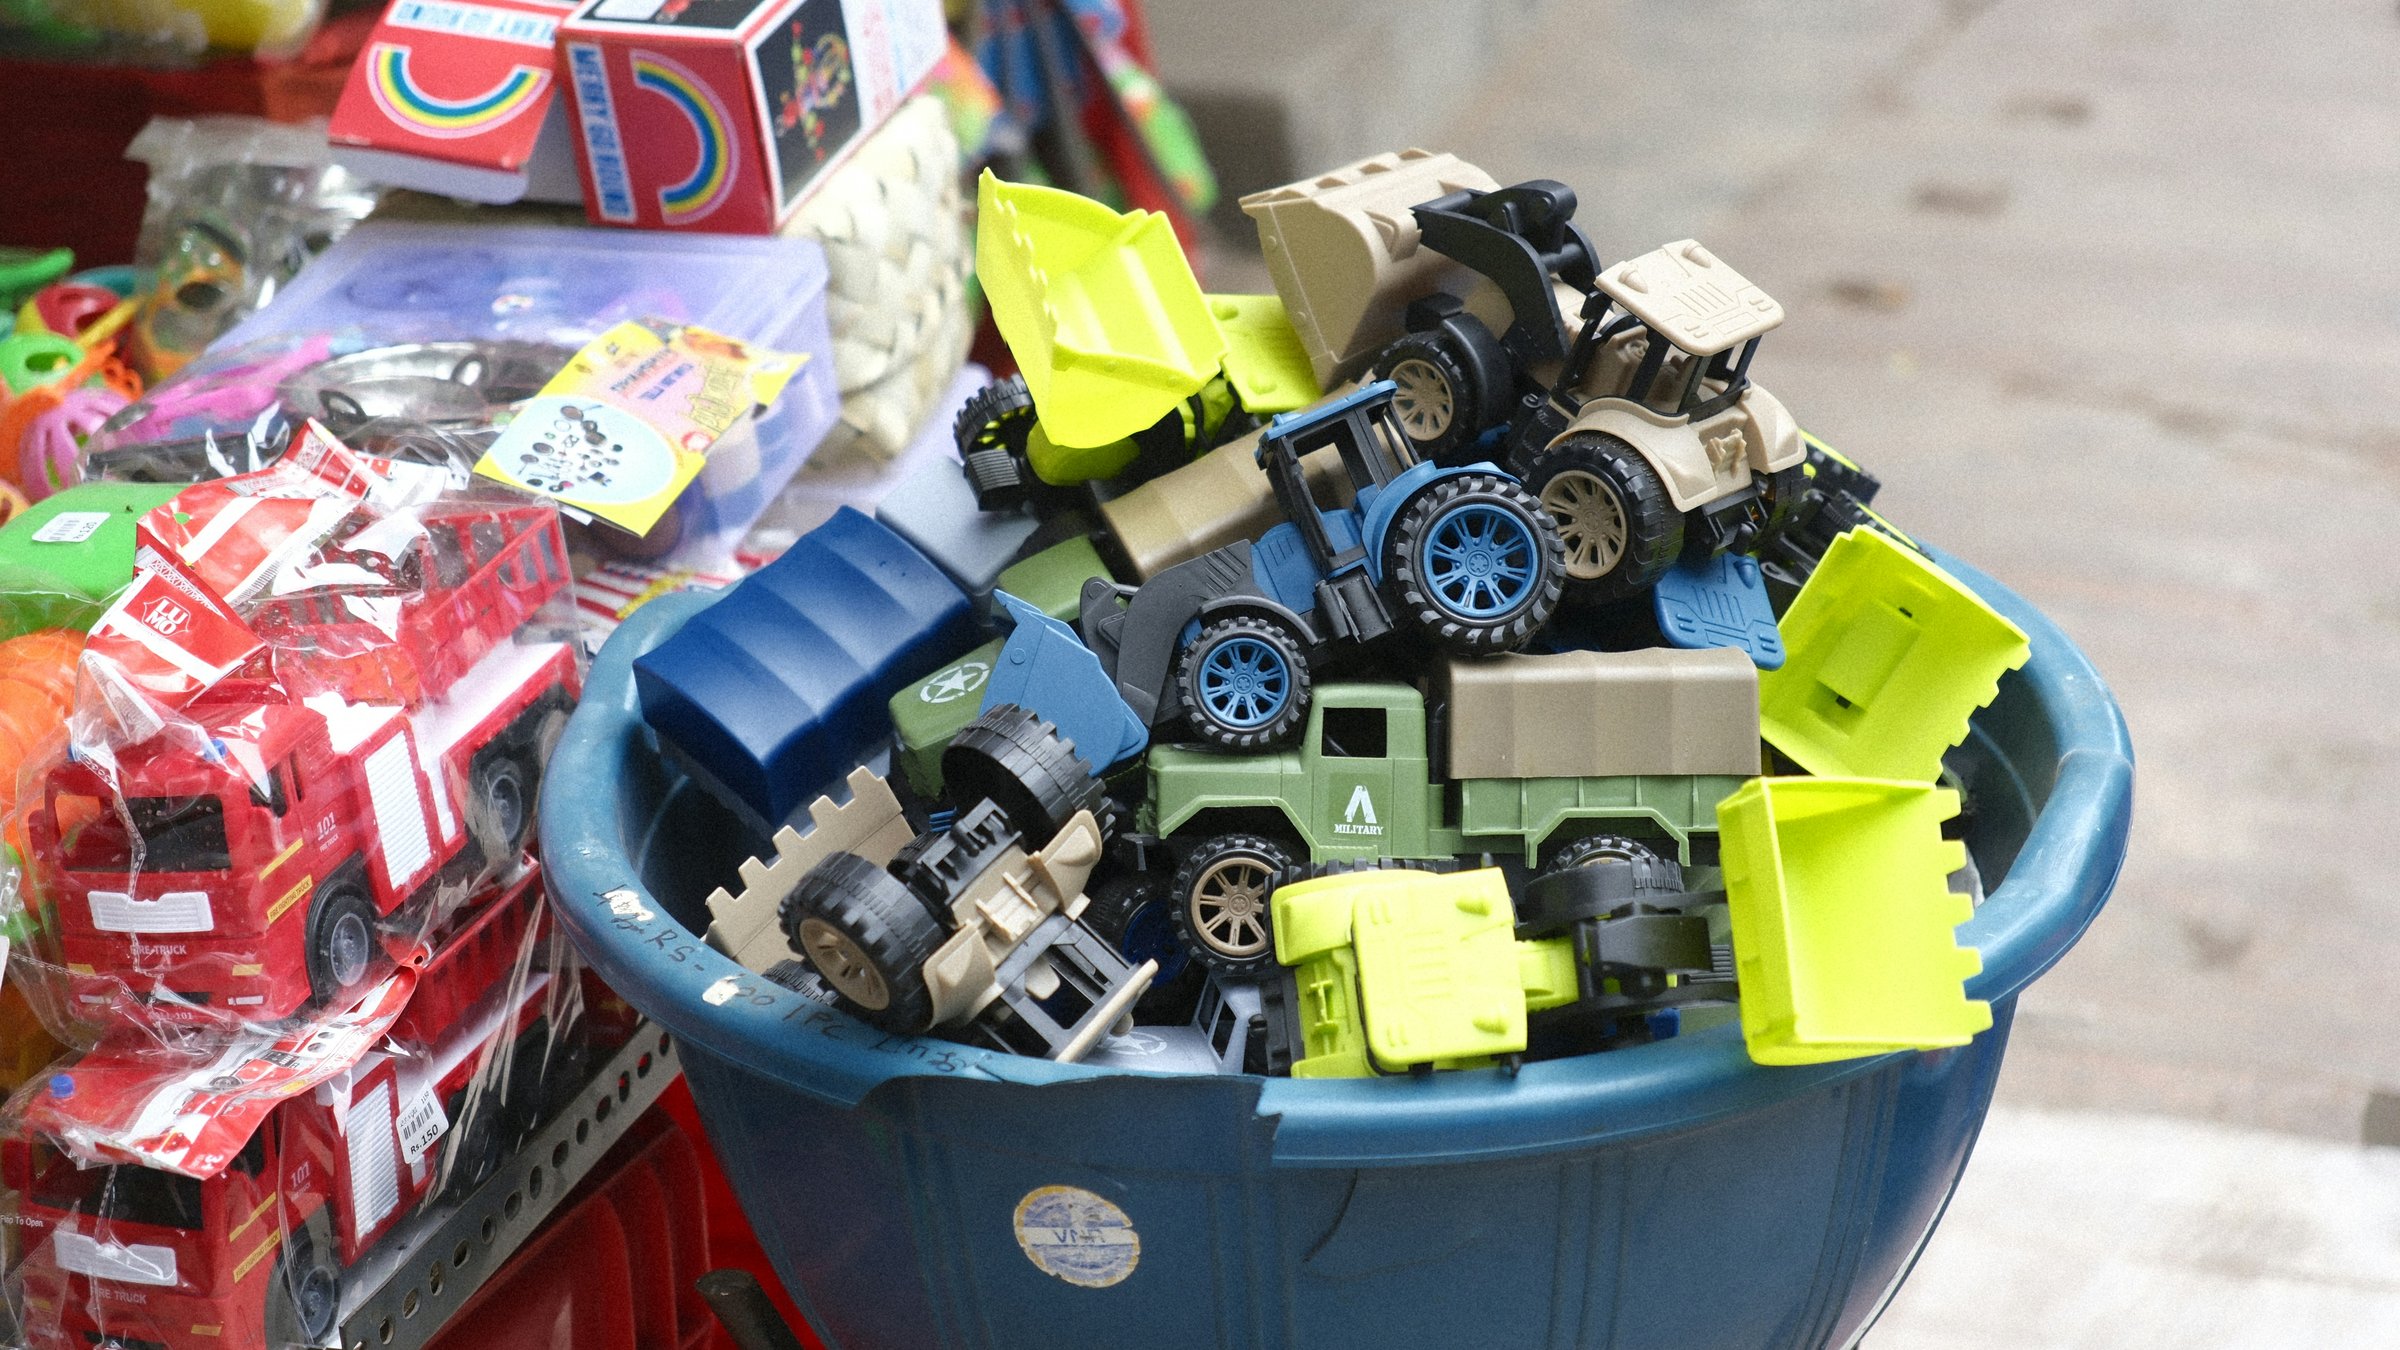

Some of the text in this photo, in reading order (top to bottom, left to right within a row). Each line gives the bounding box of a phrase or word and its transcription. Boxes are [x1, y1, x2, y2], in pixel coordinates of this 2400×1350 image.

[155, 599, 188, 625] LU
[145, 610, 177, 634] MO
[316, 812, 336, 841] 101
[1333, 824, 1384, 835] MILITARY
[153, 944, 187, 955] TRUCK
[175, 1012, 192, 1020] 101
[410, 1124, 439, 1155] Rs.150
[291, 1161, 310, 1188] 101
[15, 1216, 24, 1225] To
[25, 1217, 44, 1228] Open
[114, 1290, 147, 1304] TRUCK
